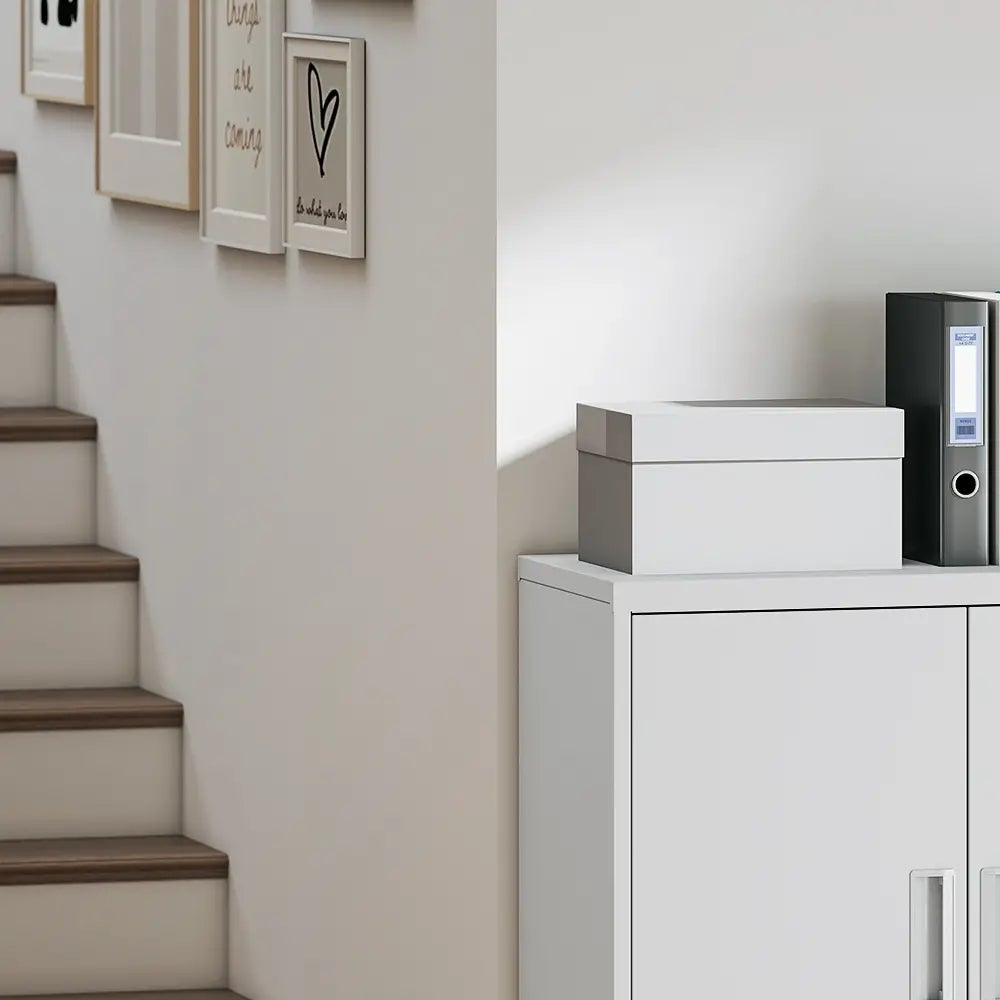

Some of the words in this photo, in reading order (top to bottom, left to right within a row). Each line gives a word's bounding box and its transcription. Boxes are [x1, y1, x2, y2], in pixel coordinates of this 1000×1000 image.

[233, 60, 254, 94] are
[224, 117, 263, 169] coming
[306, 198, 322, 217] what
[323, 208, 336, 226] you
